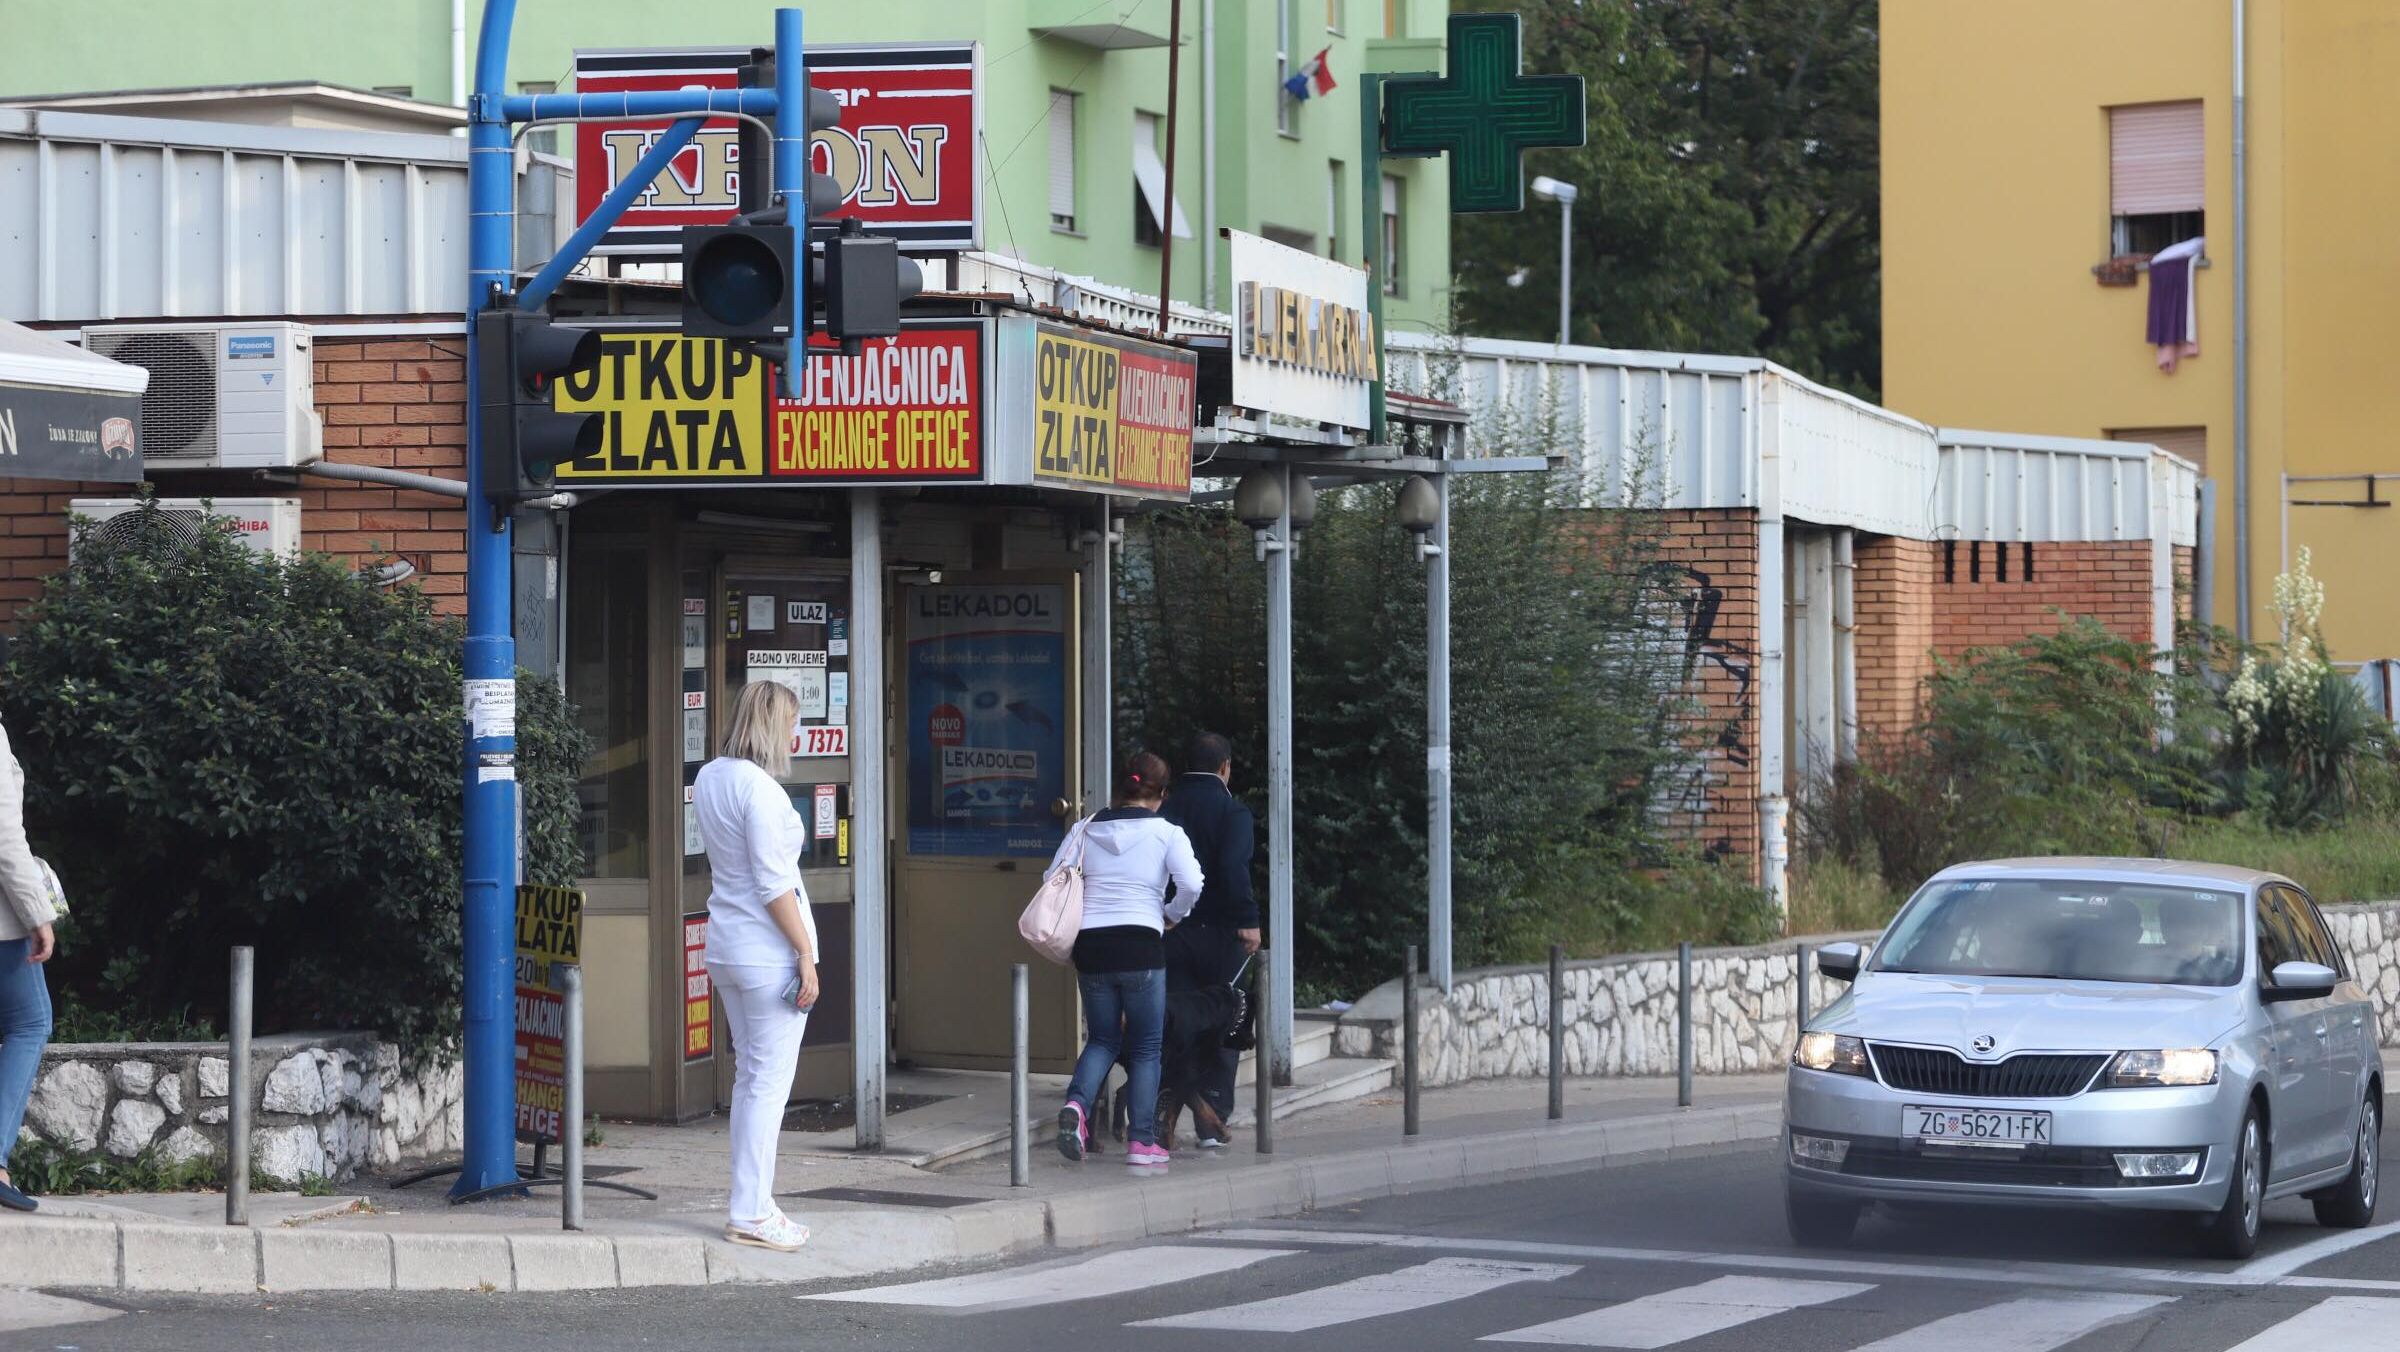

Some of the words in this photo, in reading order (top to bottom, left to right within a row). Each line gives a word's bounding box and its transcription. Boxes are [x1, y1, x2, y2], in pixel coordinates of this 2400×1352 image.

[231, 341, 272, 349] Panasonic
[1240, 281, 1378, 381] LJEKARNA
[778, 336, 968, 407] JENJAČNICA
[1039, 339, 1117, 411] OTKUP
[1120, 364, 1190, 430] MJENJAČNICA
[778, 410, 889, 470] EXCHANGE
[895, 409, 970, 469] OFFICE
[1040, 409, 1110, 478] ZLATA
[1117, 424, 1161, 482] EXCHANGE
[1161, 432, 1190, 487] OFFICE
[791, 604, 823, 620] ULAZ
[919, 593, 1049, 618] LEKADOL
[749, 652, 782, 665] RADNO
[785, 652, 825, 664] VRIJEME
[687, 693, 701, 707] EUR
[931, 717, 960, 730] NOVO
[807, 728, 844, 753] 7372
[944, 750, 1013, 769] LEKADOL
[1007, 839, 1042, 848] SANDOZ
[515, 916, 577, 958] LATA
[515, 1078, 564, 1113] HANGE
[515, 1102, 560, 1137] FICE
[1919, 1111, 1945, 1135] ZG
